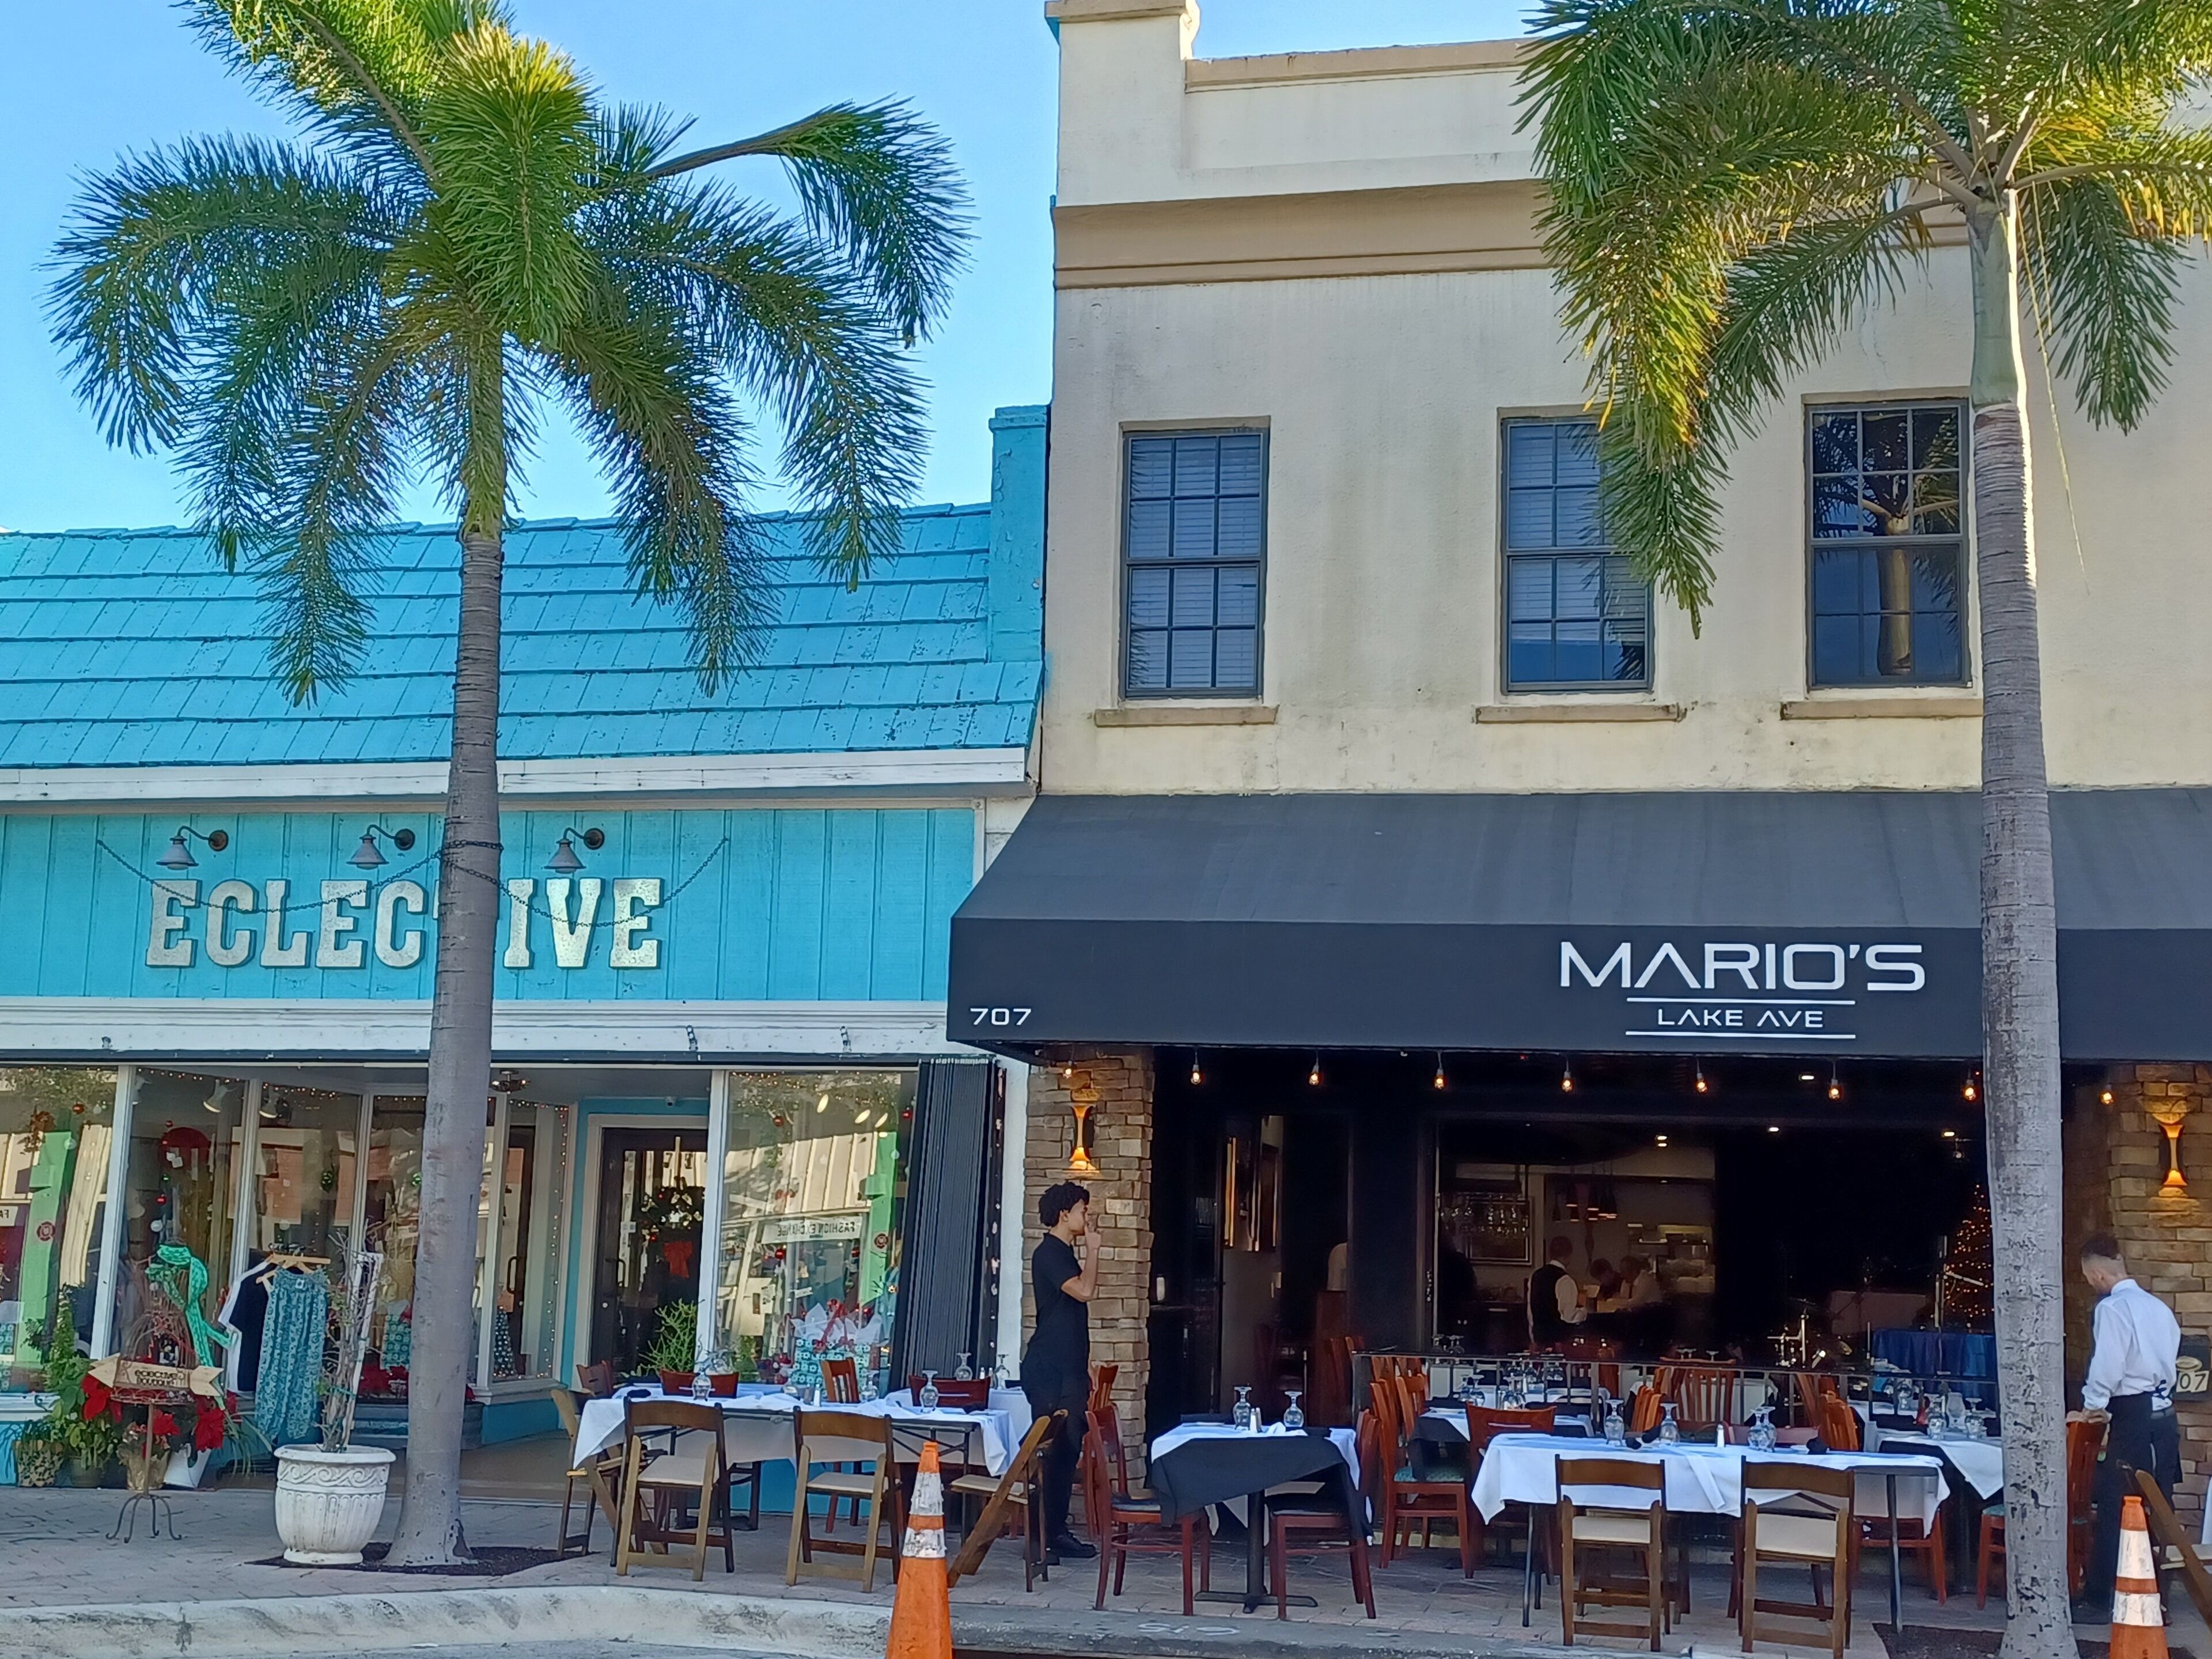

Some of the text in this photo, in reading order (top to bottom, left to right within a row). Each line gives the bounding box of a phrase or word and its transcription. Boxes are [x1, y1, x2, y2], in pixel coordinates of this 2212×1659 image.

[146, 878, 664, 969] ECLECIVE
[1560, 941, 1925, 991] MARIO'S
[970, 1007, 1032, 1025] 707
[1657, 1009, 1823, 1028] LAKE AVE
[2180, 1373, 2206, 1391] 07
